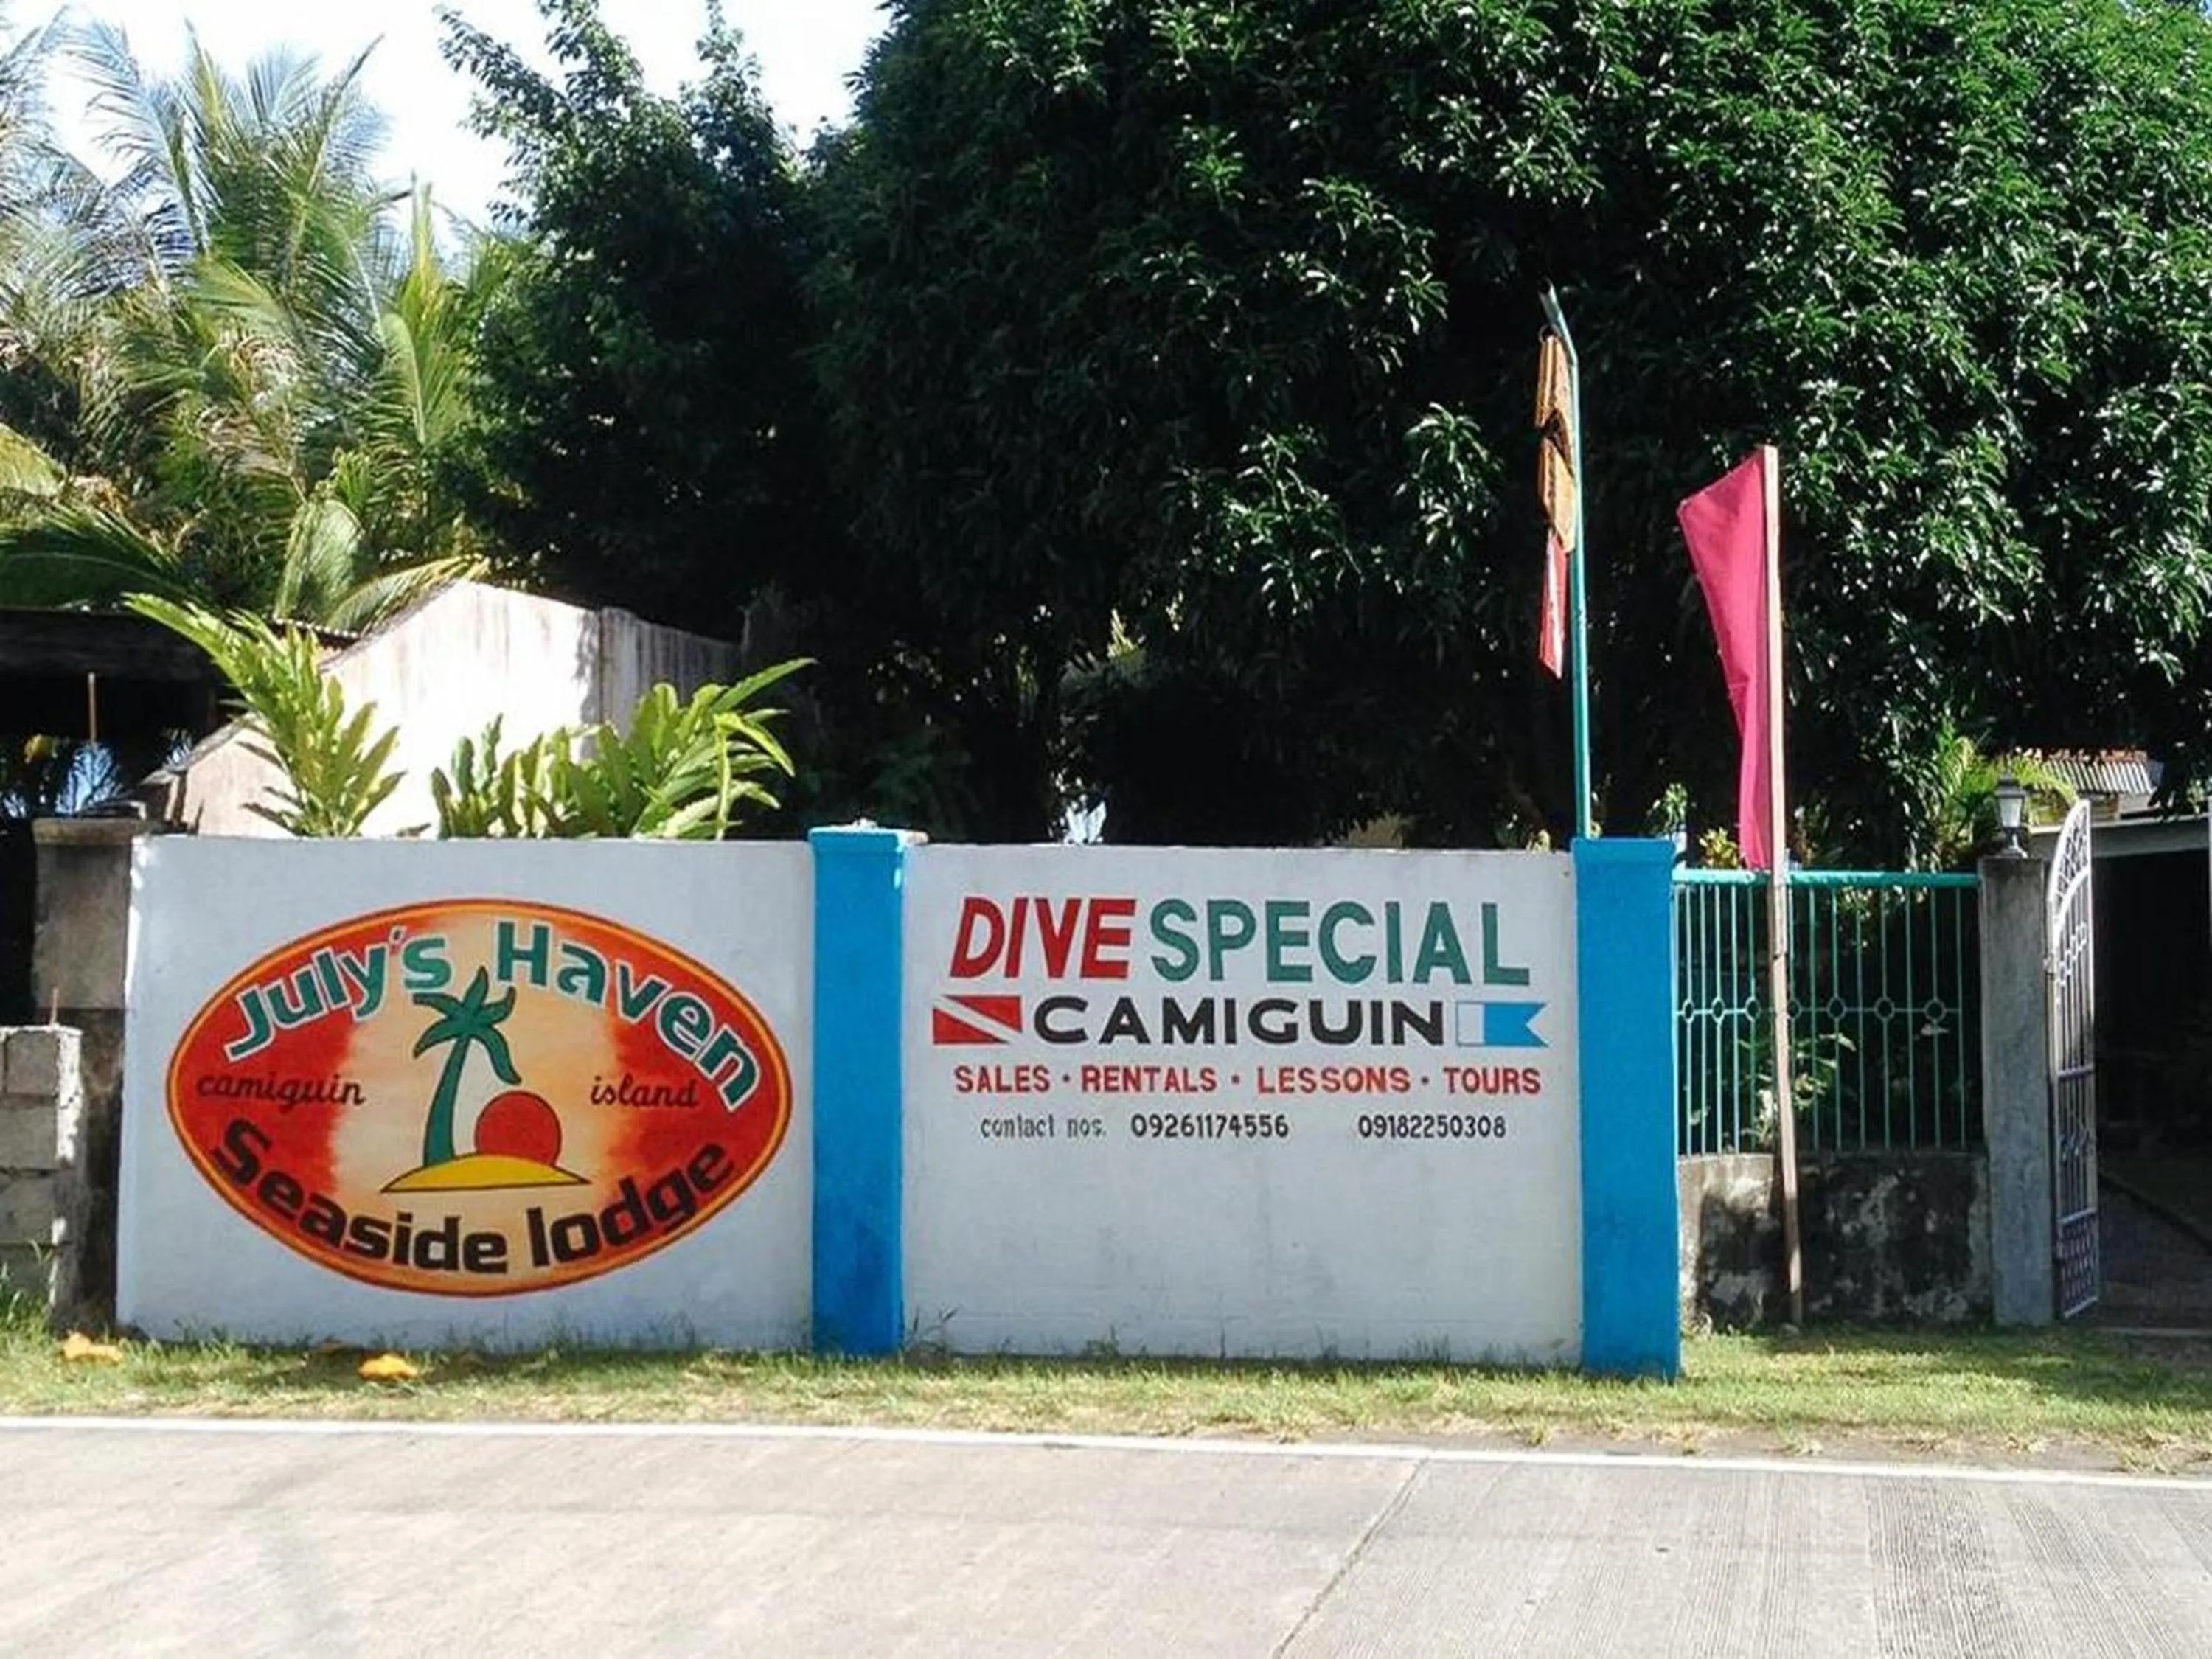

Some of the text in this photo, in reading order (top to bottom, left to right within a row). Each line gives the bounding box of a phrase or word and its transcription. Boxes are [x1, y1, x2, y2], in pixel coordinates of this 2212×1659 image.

[949, 897, 1531, 986] DIVE SPECIAL
[224, 919, 762, 1112] July's Haven
[1034, 995, 1444, 1046] CAMIGUIN
[196, 1071, 367, 1112] camiguin
[591, 1073, 701, 1110] island
[954, 1065, 1542, 1095] SALES RENTALS LESSONS TOURS
[980, 1114, 1506, 1139] contact nos. 09261174556 09182250308
[211, 1117, 735, 1273] Seaside lodge
